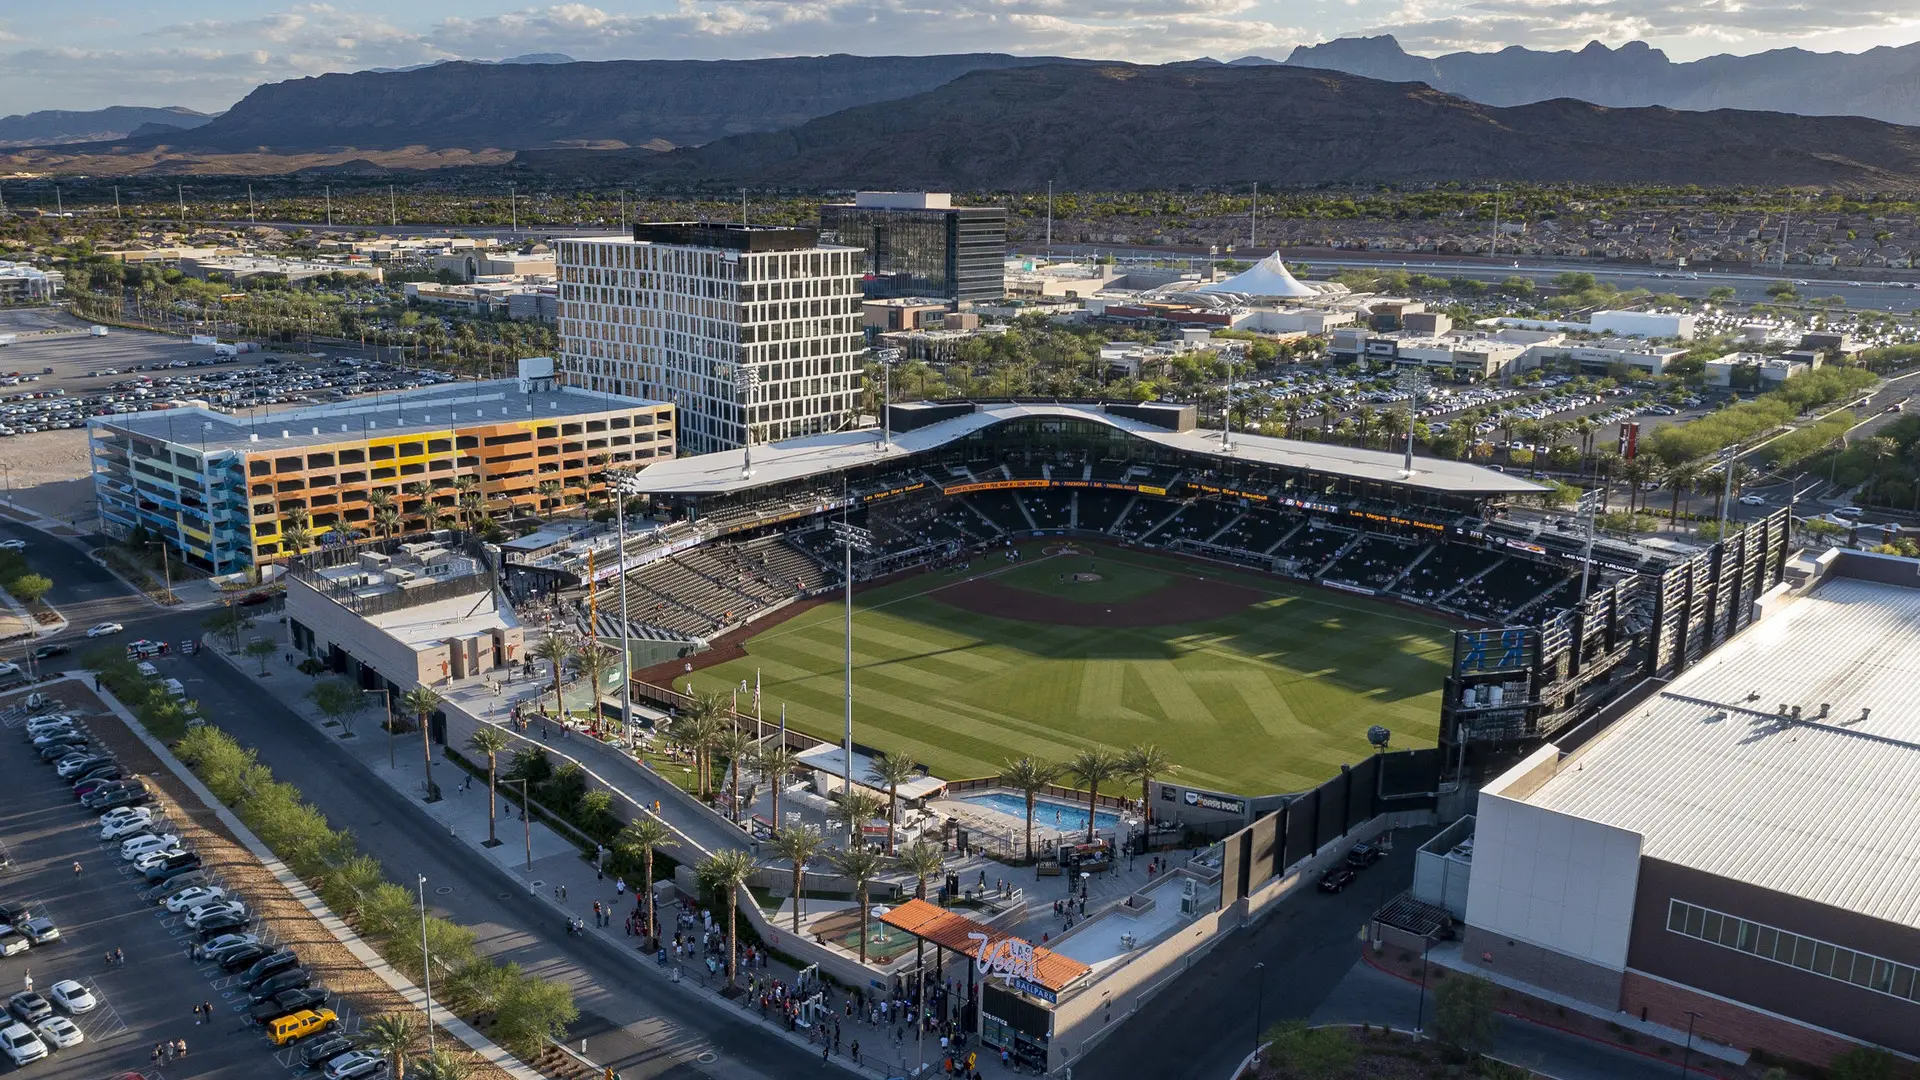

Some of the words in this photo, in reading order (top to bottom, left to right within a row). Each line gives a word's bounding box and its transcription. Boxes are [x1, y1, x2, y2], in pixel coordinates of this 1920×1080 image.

[874, 490, 889, 498] Vegas
[890, 487, 904, 495] Stars
[905, 482, 924, 492] Baseball
[1202, 485, 1219, 493] Vegas
[1242, 491, 1268, 501] Baseball
[742, 522, 759, 530] Vegas
[778, 512, 801, 522] Baseball
[1366, 513, 1387, 521] Vegas
[1391, 516, 1410, 525] Stars
[1414, 520, 1444, 530] Baseball
[1202, 799, 1220, 809] OASIS
[1222, 801, 1239, 812] POOL
[968, 932, 1044, 986] Vegas
[1010, 942, 1031, 960] LAS
[1016, 980, 1054, 1002] BALLPARK
[992, 1016, 1008, 1026] OFFICE
